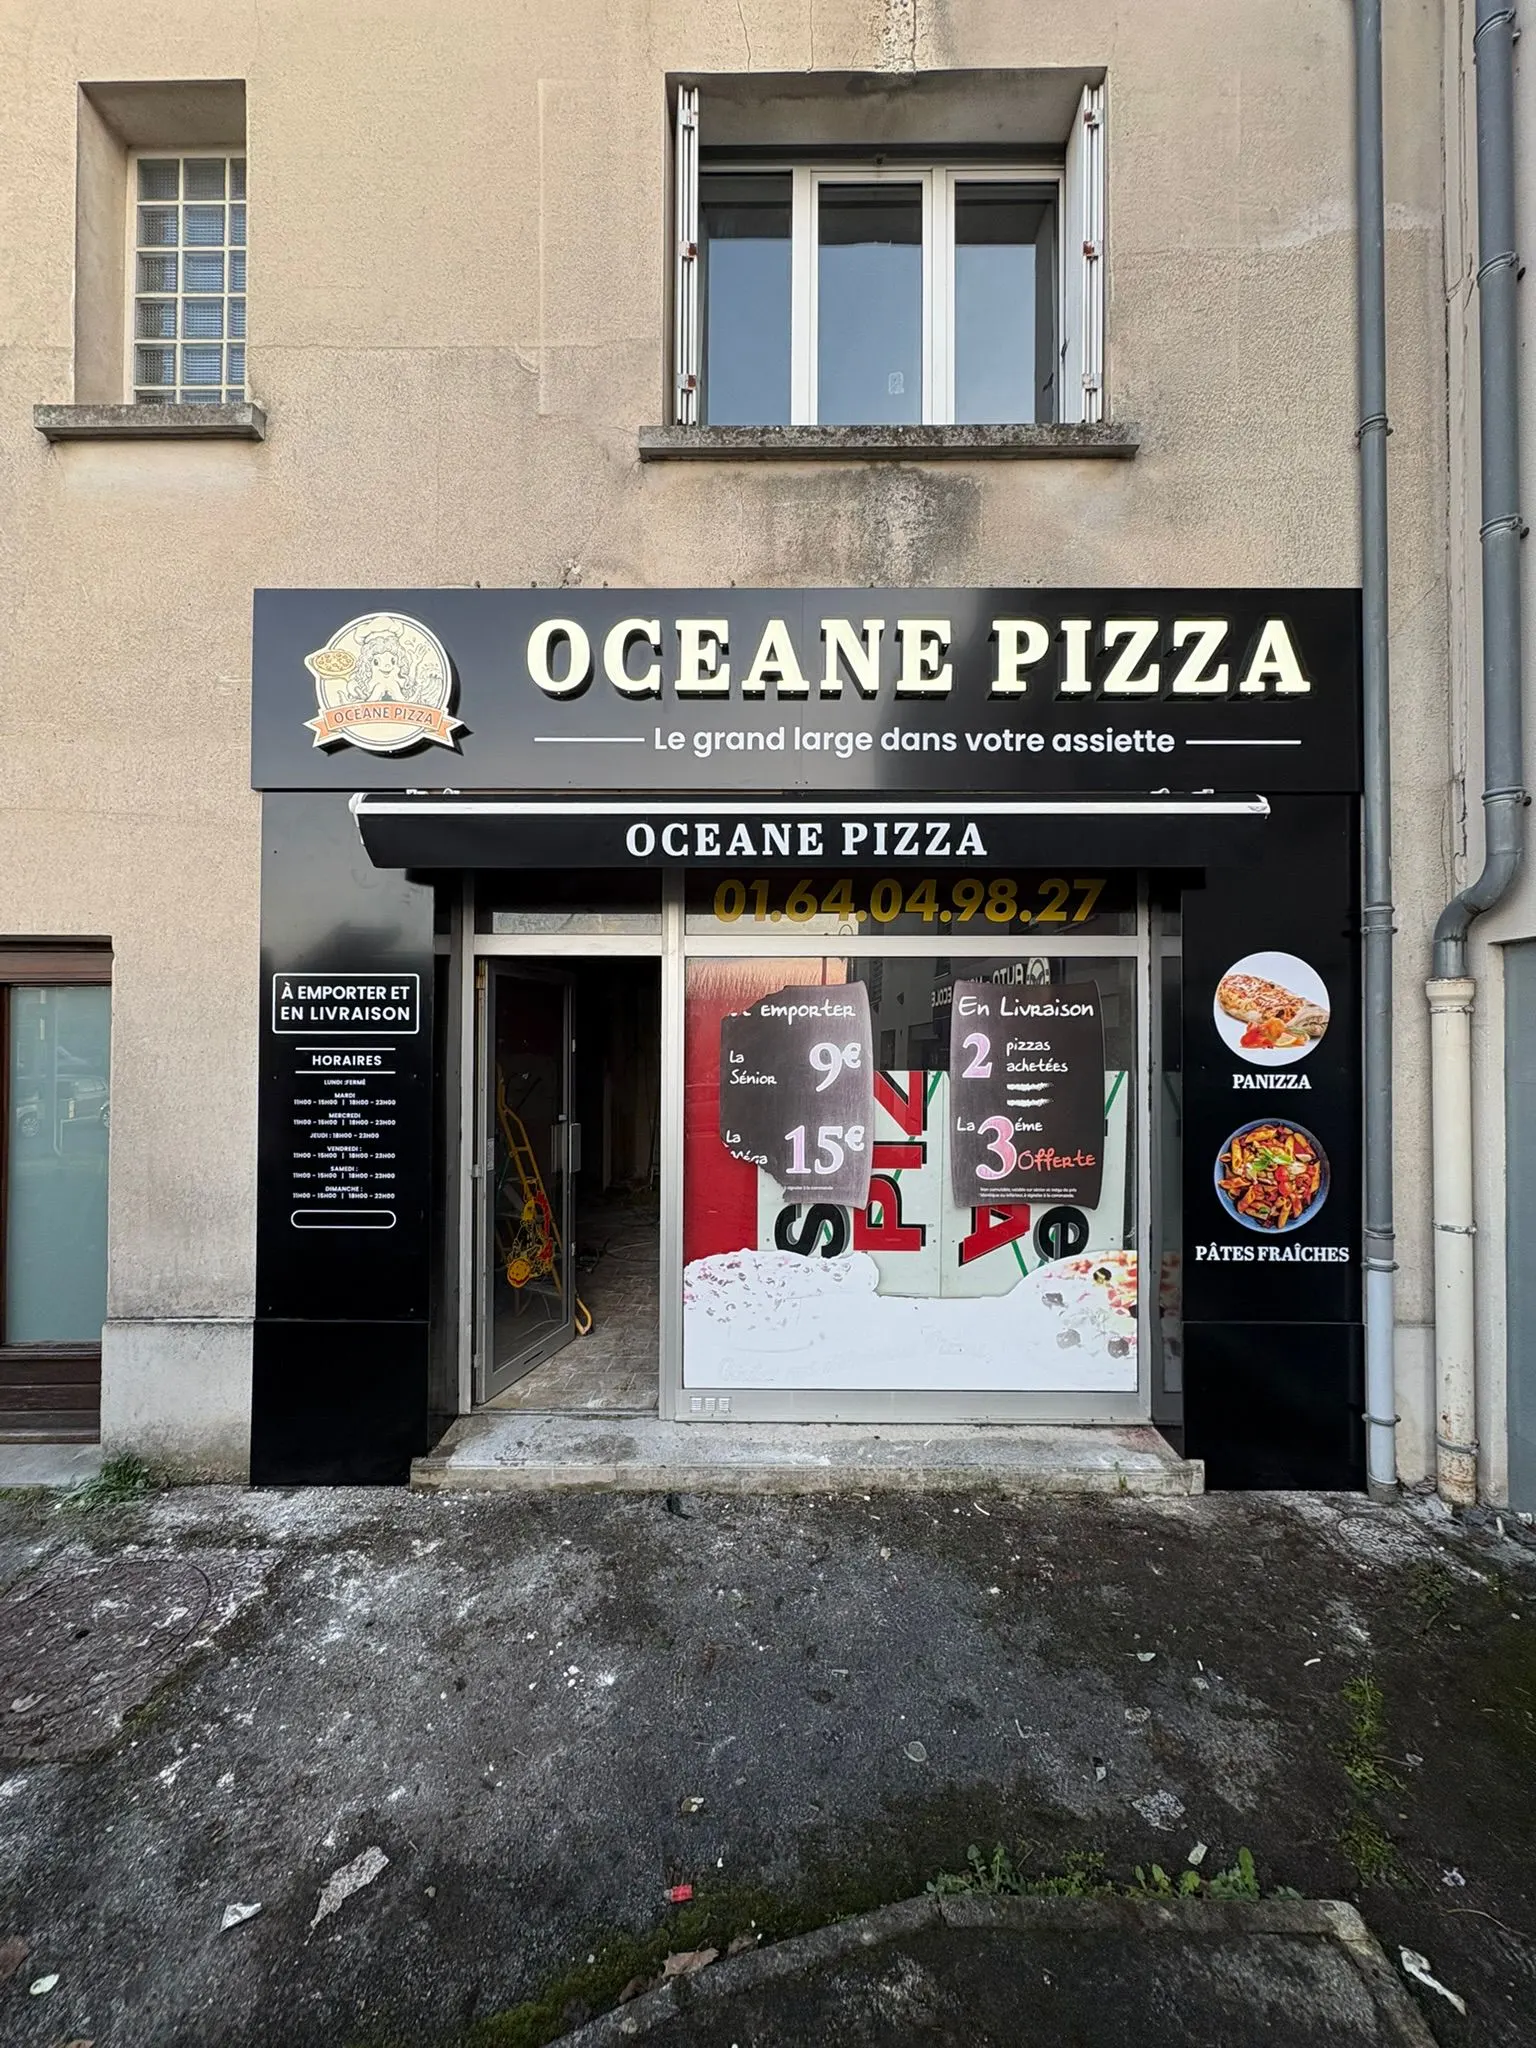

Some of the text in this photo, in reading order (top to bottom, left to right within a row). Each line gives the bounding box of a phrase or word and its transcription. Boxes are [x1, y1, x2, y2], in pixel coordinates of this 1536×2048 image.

[527, 619, 1311, 695] OCEANE PIZZA
[334, 706, 433, 725] OCEANE PIZZA
[654, 726, 1175, 759] Le grand large dans votre assiette
[626, 822, 988, 857] OCEANE PIZZA
[713, 878, 1107, 923] 01.64.04.98.27
[280, 981, 411, 1000] À EMPORTER ET
[280, 1006, 410, 1021] EN LIVRAISON
[958, 995, 1095, 1018] En Livraison
[728, 1050, 745, 1064] La
[961, 1032, 993, 1079] 2
[1006, 1037, 1051, 1060] pizzas
[312, 1054, 382, 1066] HORAIRES
[1006, 1057, 1069, 1074] achetées
[729, 1067, 778, 1086] Sénior
[1232, 1074, 1312, 1090] PANIZZA
[957, 1116, 976, 1132] La
[725, 1129, 742, 1144] La
[1017, 1149, 1097, 1171] Offerte
[1195, 1241, 1350, 1263] PÂTES FRAÎCHES
